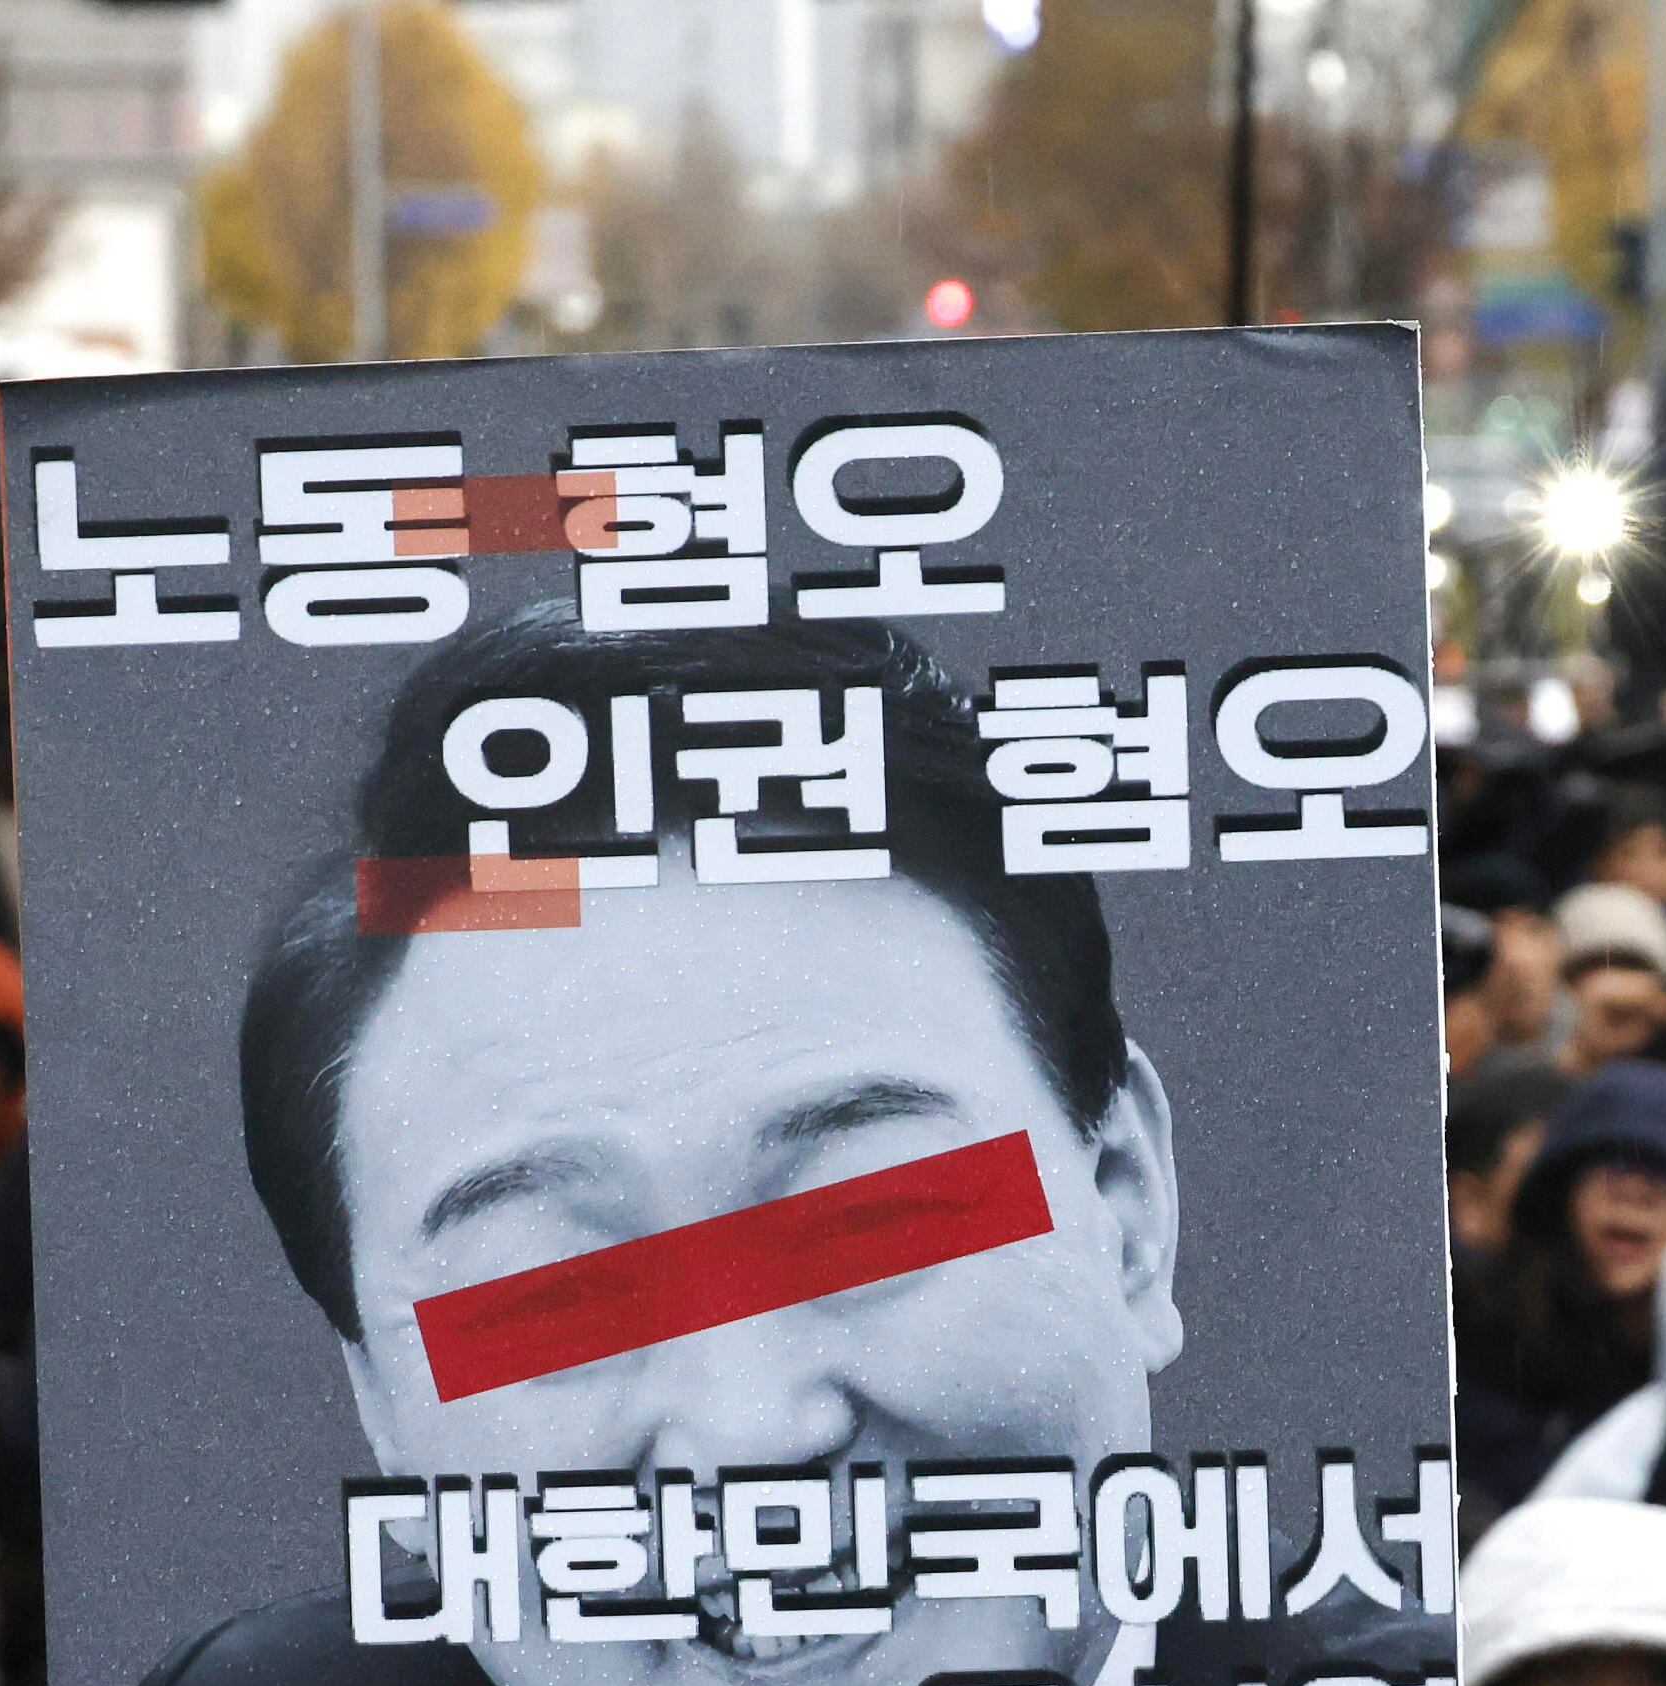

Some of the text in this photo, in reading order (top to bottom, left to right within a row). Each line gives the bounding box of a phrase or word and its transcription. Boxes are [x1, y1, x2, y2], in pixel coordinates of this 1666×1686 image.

[35, 413, 1006, 647] 노동 혐오
[442, 660, 1429, 891] 인권 혐오
[347, 1450, 1455, 1644] 대한민국에서
